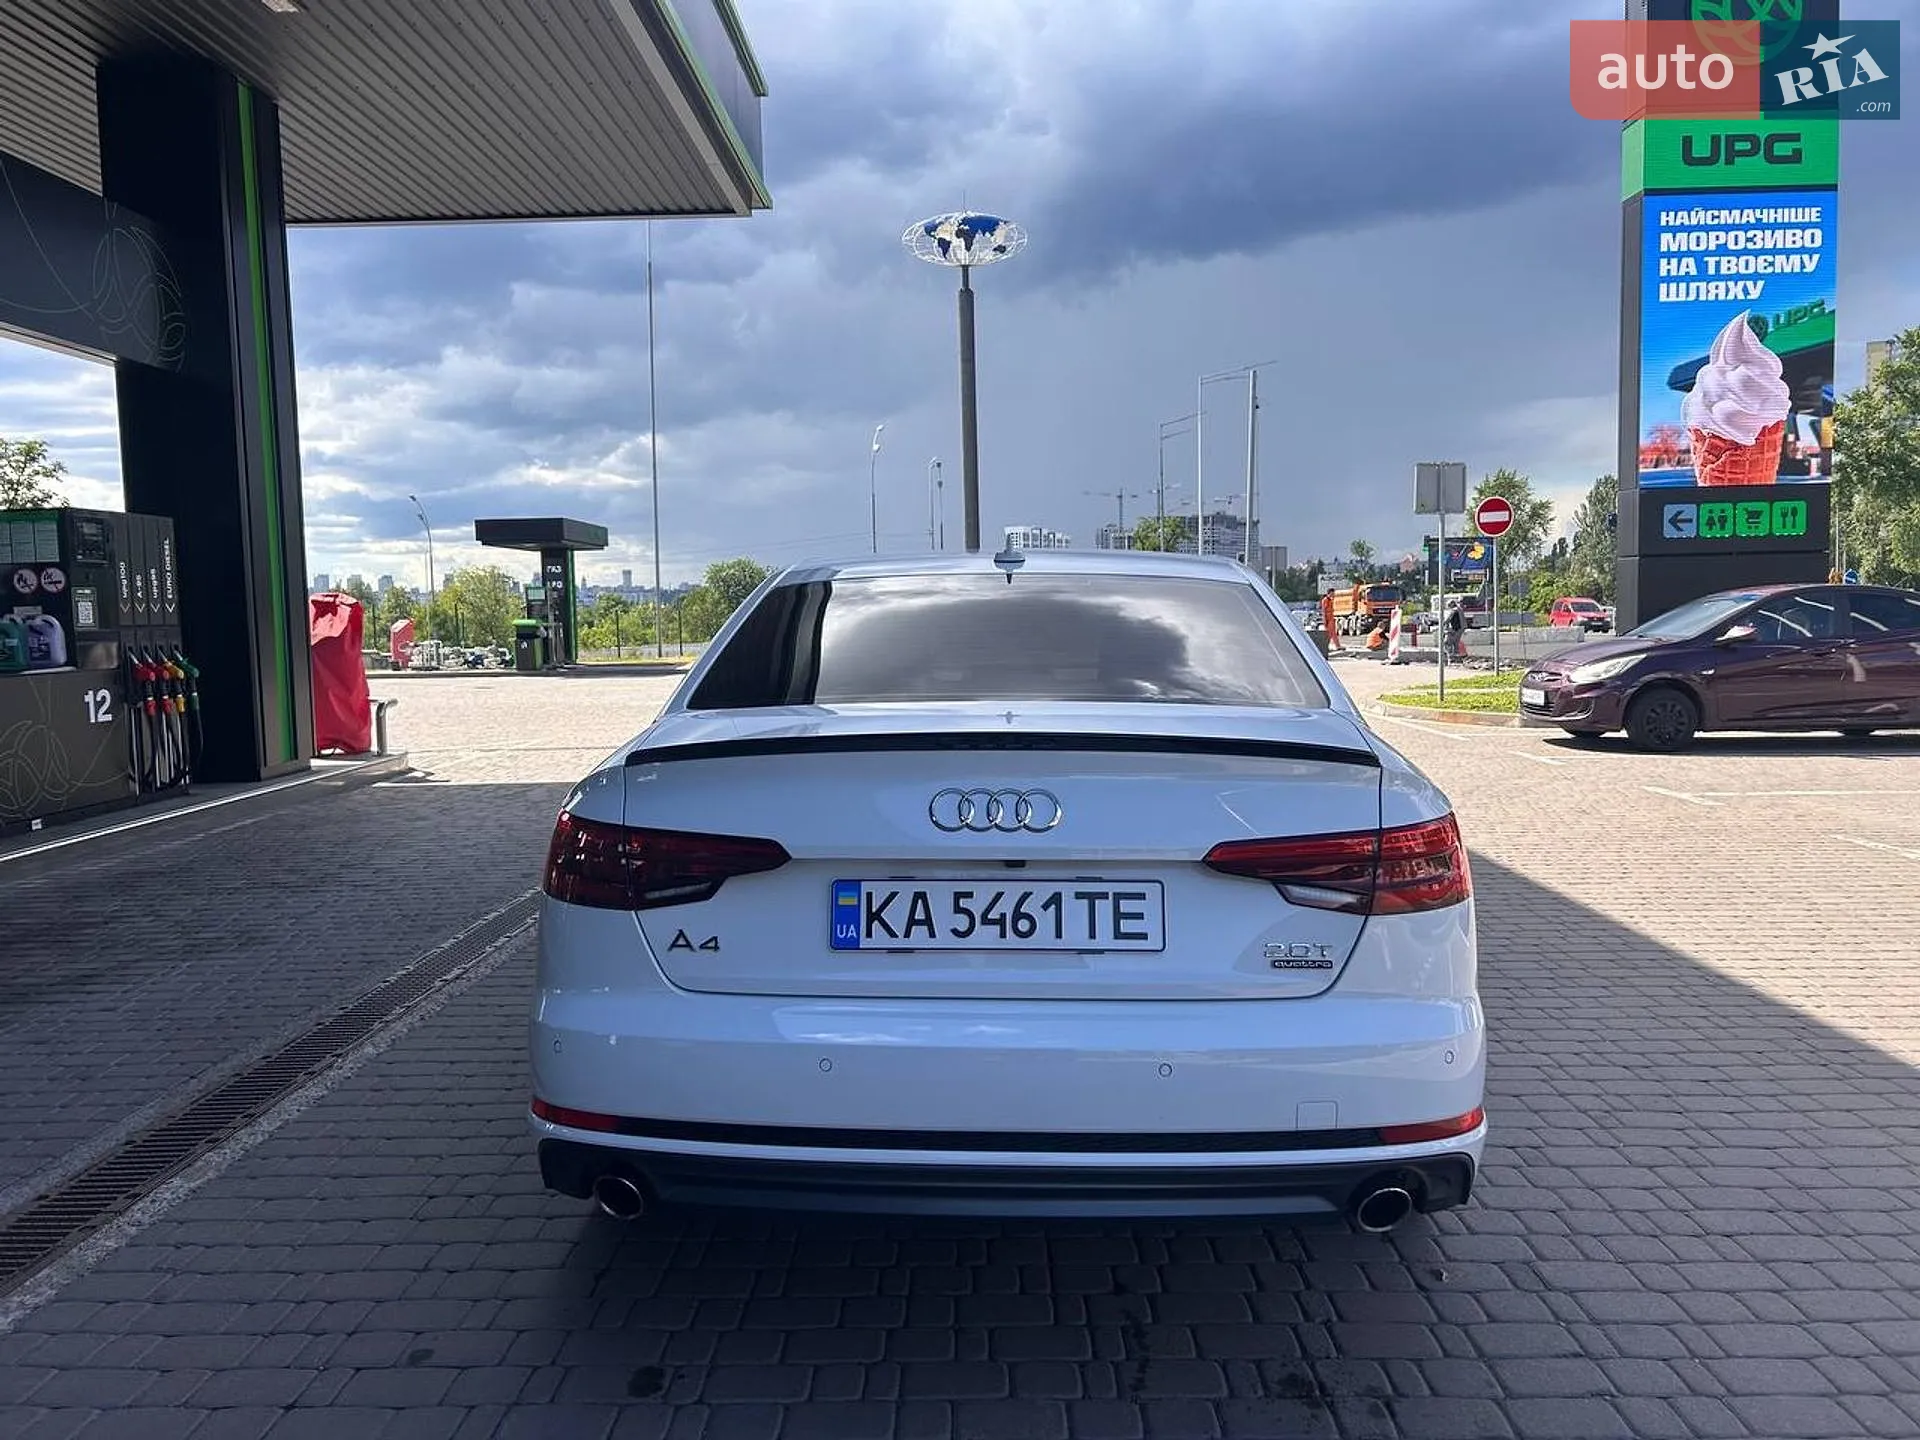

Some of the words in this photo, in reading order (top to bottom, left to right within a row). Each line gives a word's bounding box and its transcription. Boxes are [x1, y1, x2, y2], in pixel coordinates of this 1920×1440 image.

[1681, 132, 1803, 166] UPG
[1660, 206, 1822, 227] НАЙСМАЧНІШЕ
[1659, 228, 1822, 252] МОРОЗИВО
[1659, 257, 1698, 277] НА
[1704, 253, 1820, 276] ТВОЄМУ
[1659, 279, 1765, 302] ШЛЯХУ
[84, 688, 113, 723] 12
[864, 891, 937, 939] KA
[950, 891, 1063, 939] 5461
[1074, 891, 1149, 940] TE
[667, 928, 720, 952] A4
[837, 924, 858, 938] UA
[1274, 960, 1332, 969] quattro
